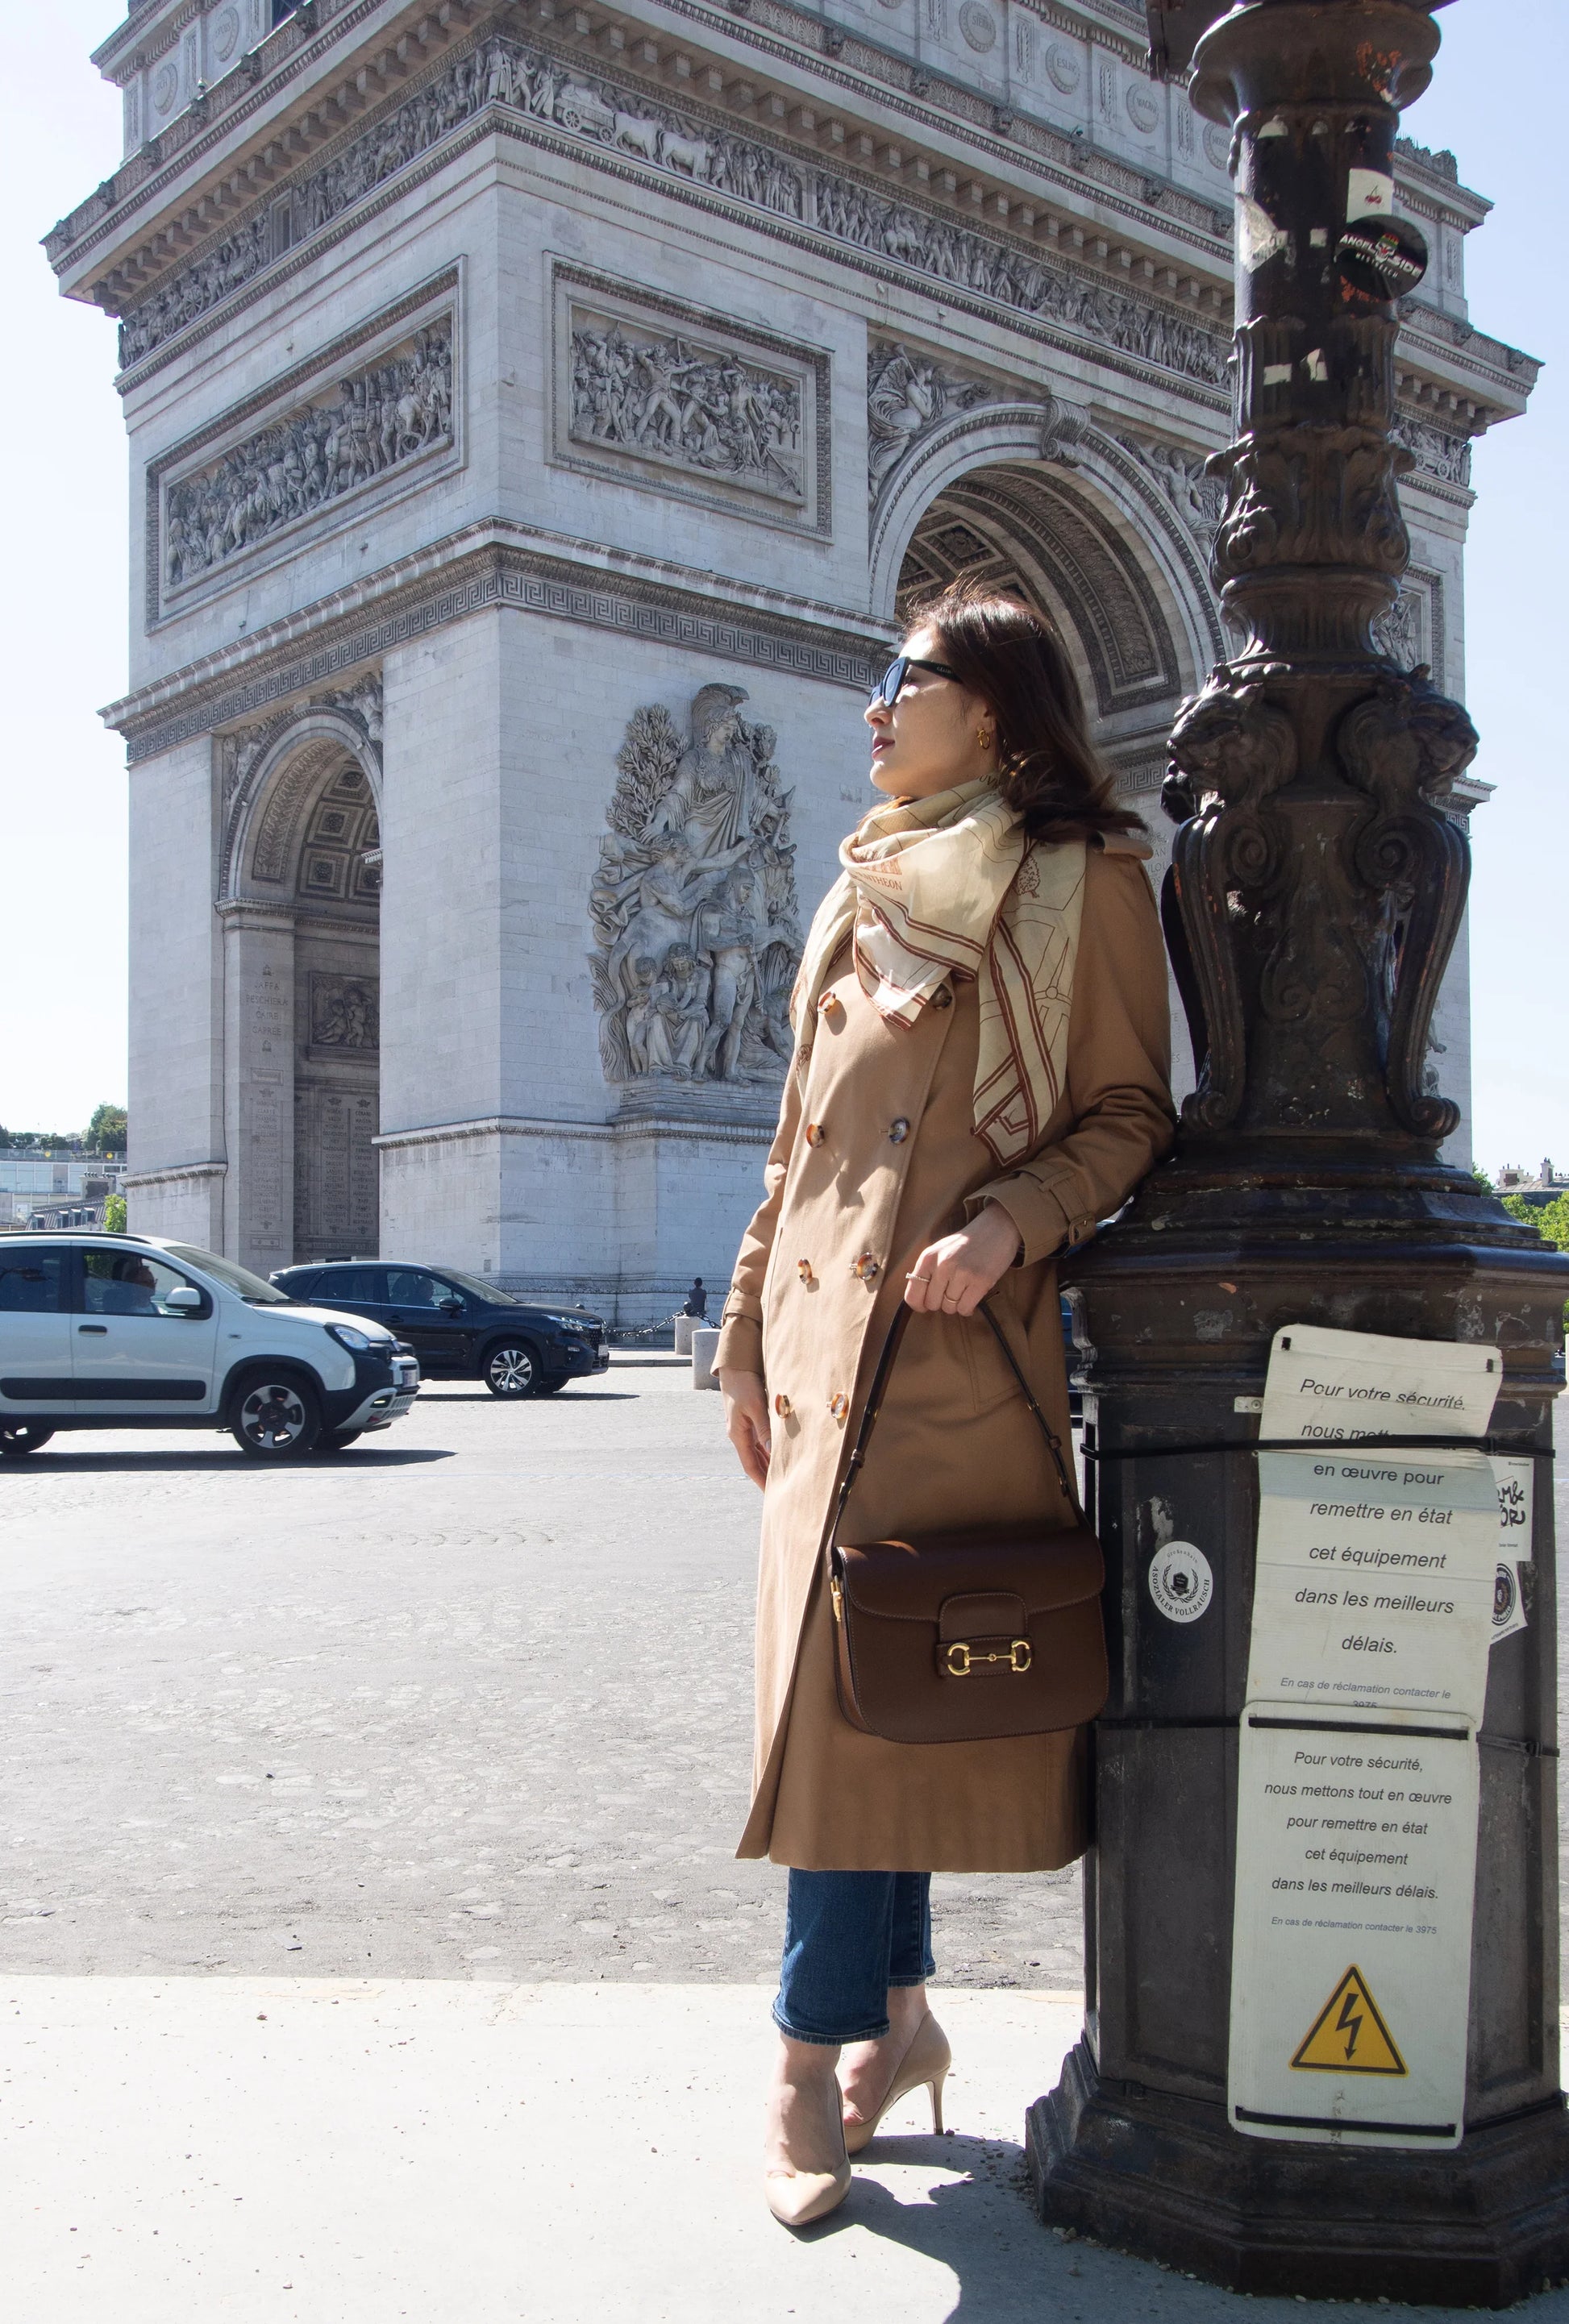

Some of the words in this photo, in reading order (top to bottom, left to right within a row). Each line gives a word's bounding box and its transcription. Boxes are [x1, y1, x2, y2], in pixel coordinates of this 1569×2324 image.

[1301, 1379, 1344, 1396] Pour
[1349, 1388, 1391, 1401] votre
[1301, 1425, 1345, 1440] nous
[1314, 1465, 1334, 1476] en
[1342, 1468, 1397, 1481] œuvre
[1404, 1473, 1444, 1485] pour
[1310, 1503, 1384, 1520] remettre
[1391, 1509, 1412, 1521] en
[1418, 1507, 1453, 1524] état
[1309, 1546, 1337, 1560] cet
[1342, 1547, 1446, 1568] équipement
[1151, 1565, 1174, 1612] ASOZIALER
[1175, 1578, 1210, 1616] VOLLRAUSCH
[1296, 1588, 1338, 1604] dans
[1343, 1590, 1368, 1607] les
[1374, 1595, 1454, 1613] meilleurs
[1342, 1636, 1396, 1653] délais.
[1280, 1677, 1295, 1687] En
[1296, 1680, 1315, 1690] cas
[1317, 1680, 1330, 1690] de
[1333, 1682, 1390, 1694] réclamation
[1392, 1687, 1441, 1698] contacter
[1441, 1689, 1451, 1699] le
[1294, 1752, 1327, 1765] Pour
[1330, 1756, 1363, 1767] votre
[1367, 1757, 1422, 1773] sécurité,
[1264, 1784, 1298, 1795] nous
[1301, 1786, 1355, 1798] mettons
[1359, 1788, 1384, 1800] tout
[1387, 1791, 1405, 1802] en
[1409, 1793, 1451, 1804] œuvre
[1287, 1818, 1318, 1829] pour
[1321, 1819, 1377, 1831] remettre
[1380, 1823, 1398, 1833] en
[1402, 1822, 1428, 1834] état
[1305, 1848, 1326, 1860] cet
[1330, 1848, 1408, 1865] équipement
[1272, 1877, 1304, 1890] dans
[1309, 1879, 1327, 1892] les
[1331, 1881, 1392, 1895] meilleurs
[1396, 1885, 1438, 1898] délais.
[1271, 1916, 1284, 1926] En
[1284, 1919, 1301, 1927] cas
[1301, 1918, 1313, 1927] de
[1314, 1919, 1363, 1930] réclamation
[1364, 1923, 1405, 1933] contacter
[1405, 1924, 1414, 1934] le
[1415, 1925, 1438, 1935] 3975
